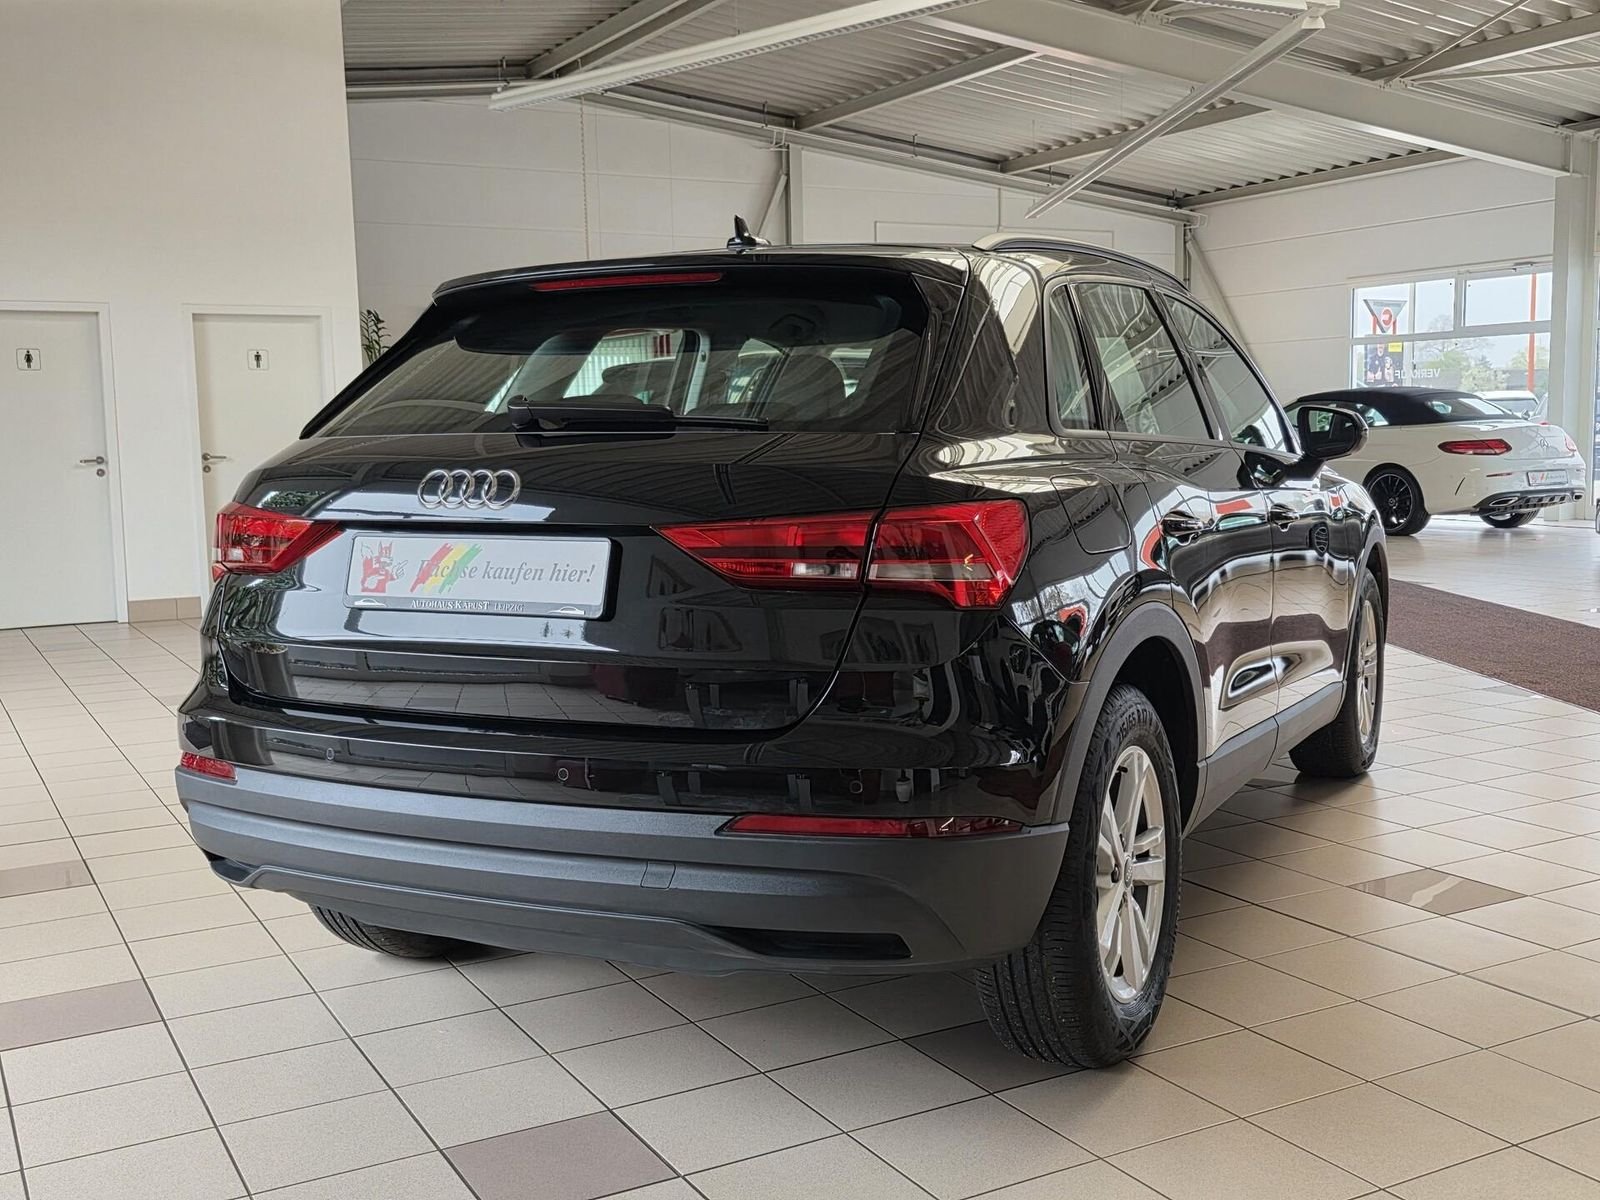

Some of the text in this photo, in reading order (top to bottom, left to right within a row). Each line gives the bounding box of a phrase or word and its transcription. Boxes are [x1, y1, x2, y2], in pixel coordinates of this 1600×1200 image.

[482, 561, 543, 585] kaufen
[549, 563, 596, 583] hier!
[411, 599, 454, 610] AUTOHAUS
[494, 602, 525, 612] LEIPZIG
